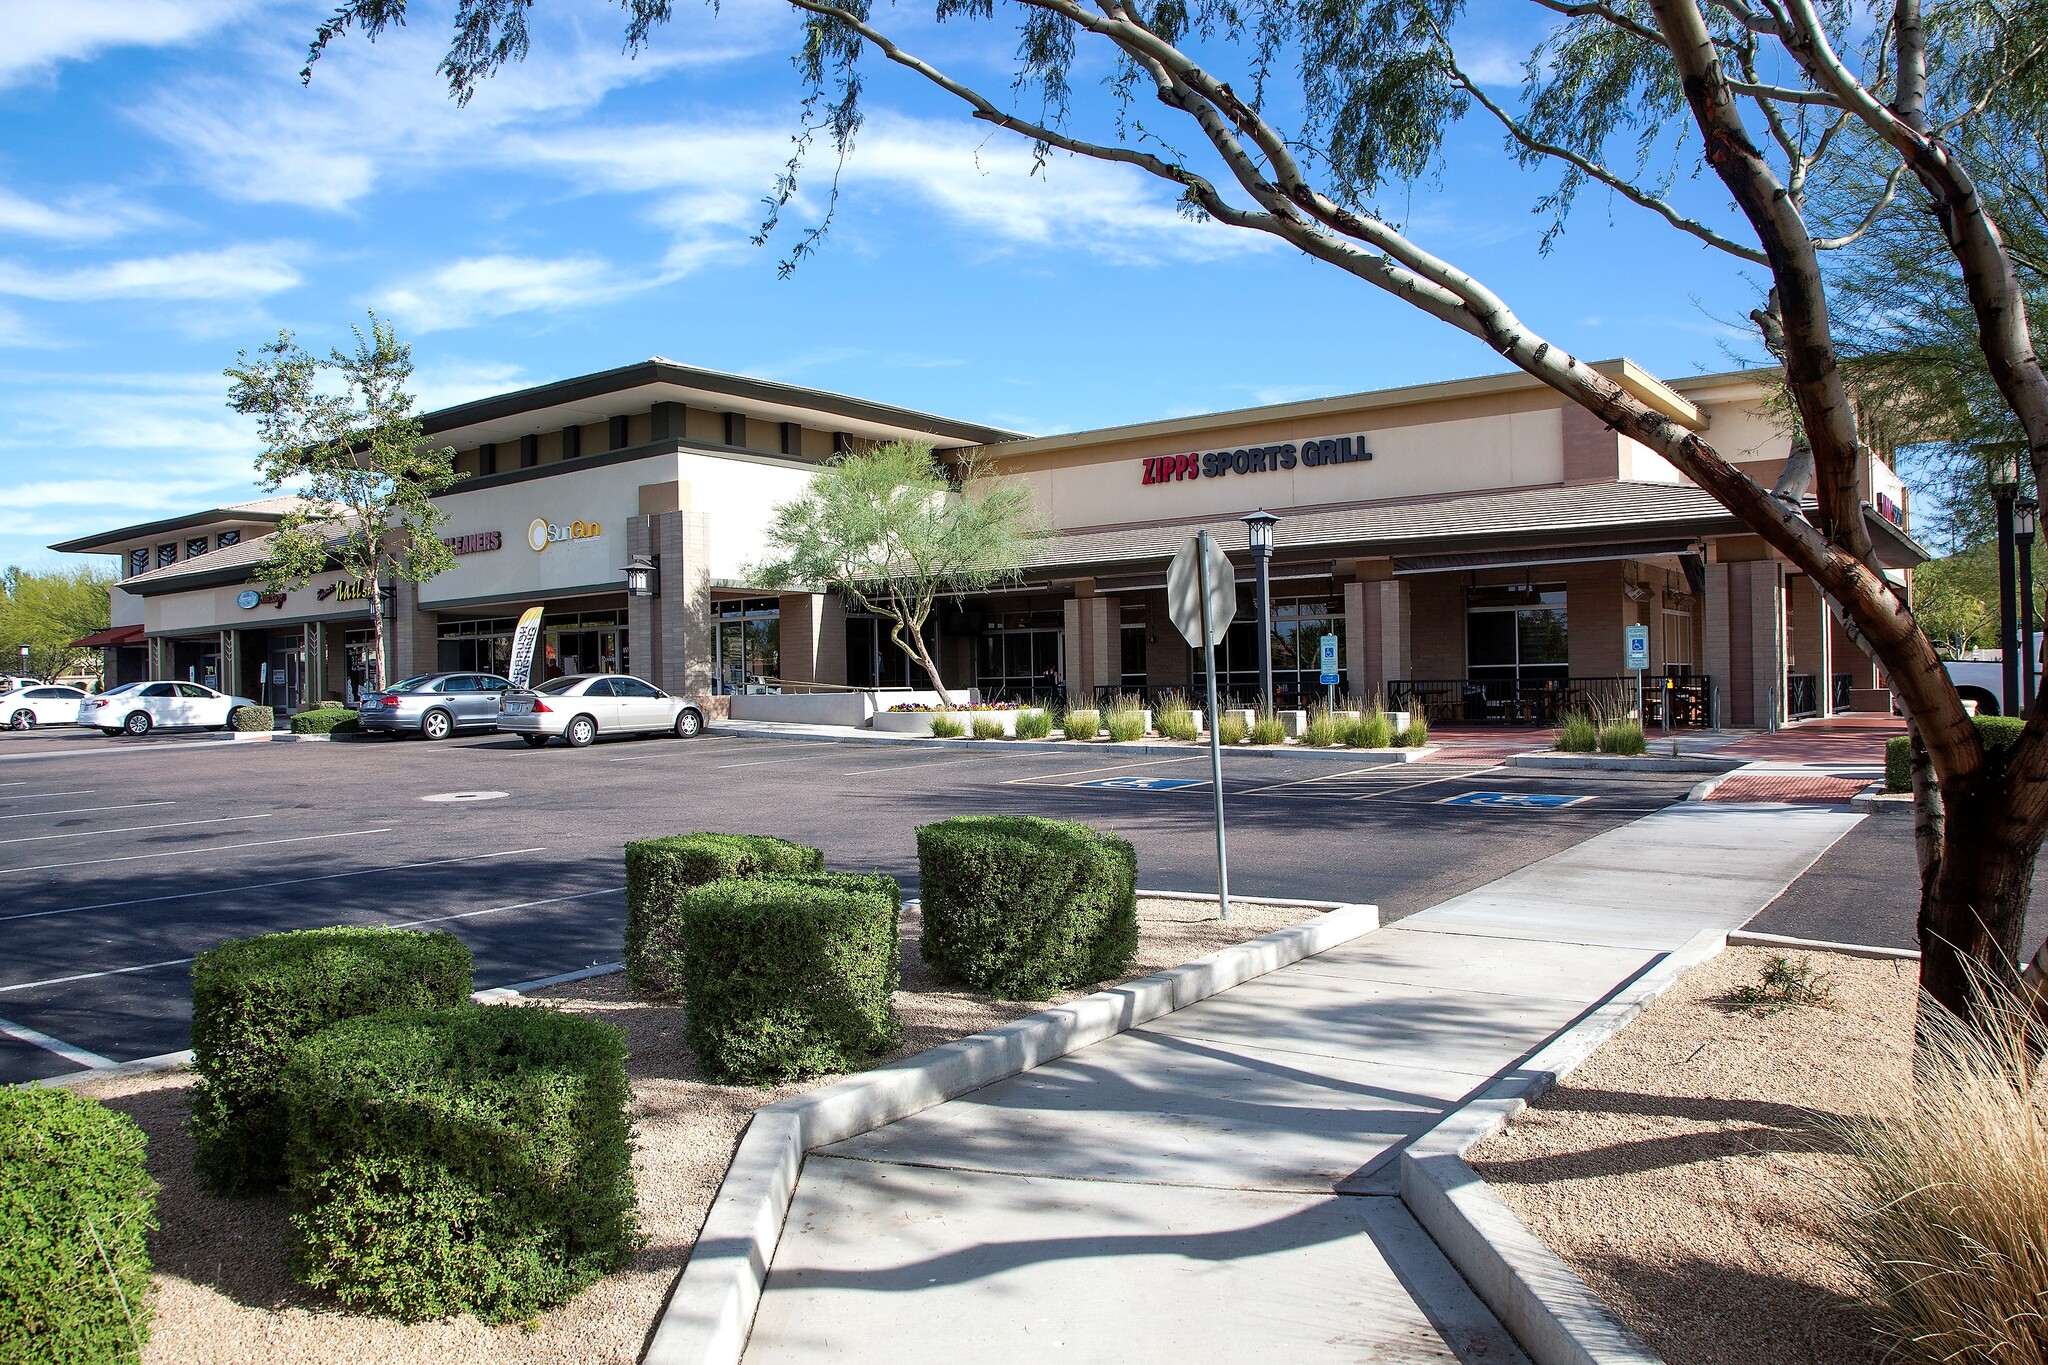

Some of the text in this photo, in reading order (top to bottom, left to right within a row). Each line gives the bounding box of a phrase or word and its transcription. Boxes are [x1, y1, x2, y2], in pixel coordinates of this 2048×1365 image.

[1142, 435, 1373, 485] ZIPPS SPORTS GRILL
